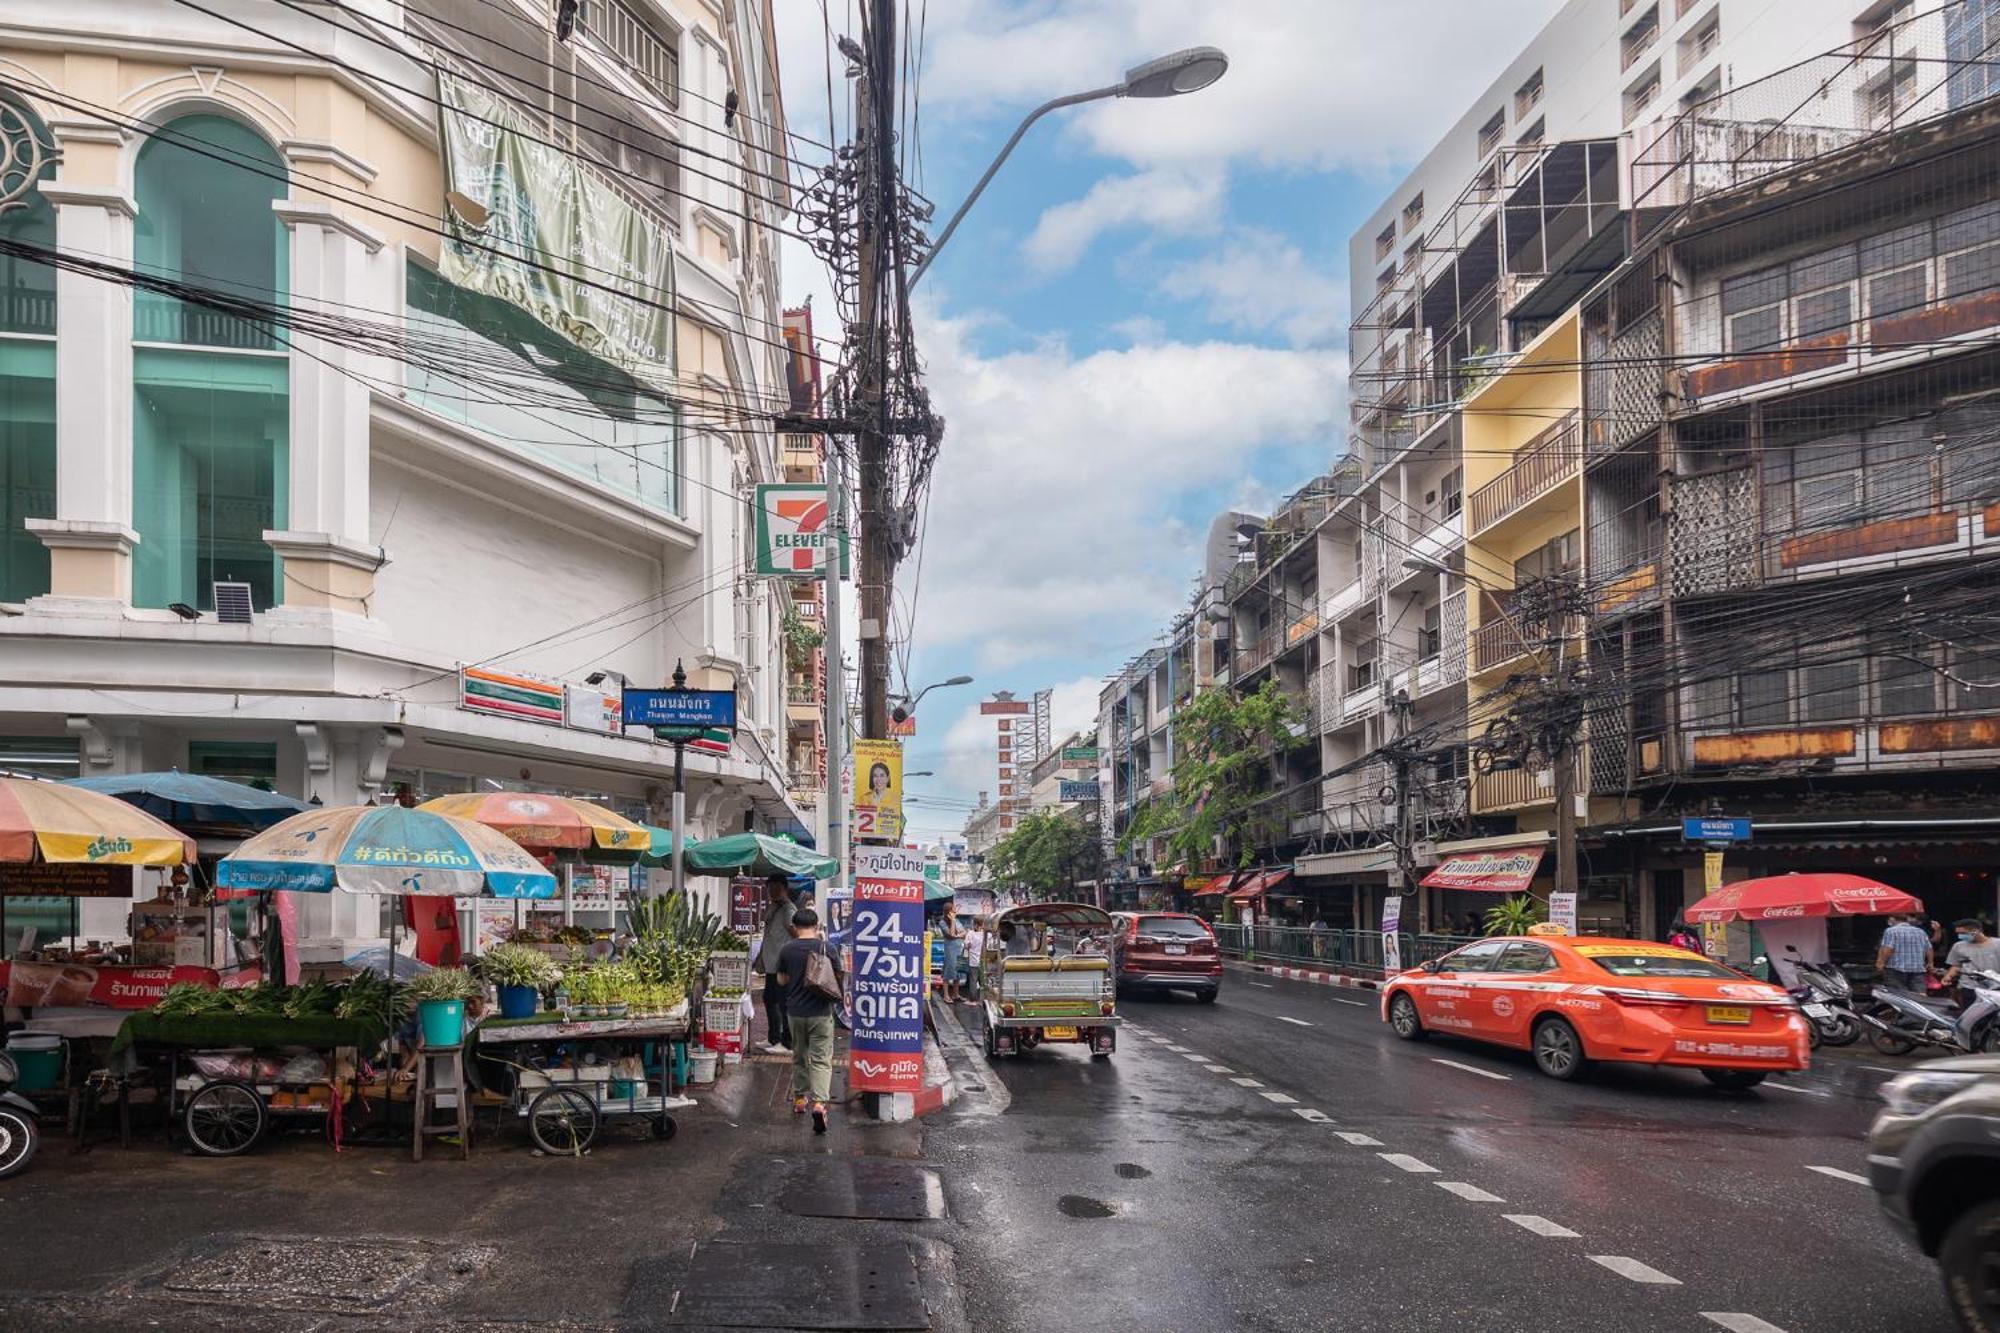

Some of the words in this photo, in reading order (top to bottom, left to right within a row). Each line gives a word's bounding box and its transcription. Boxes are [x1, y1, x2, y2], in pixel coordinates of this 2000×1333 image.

[649, 694, 711, 709] ถนนมังกร
[858, 813, 874, 832] 2
[870, 853, 924, 874] ภูมิใจไทย
[1833, 887, 1888, 897] Coca-Cola
[1763, 906, 1805, 918] Coca-Cola
[856, 911, 903, 943] 24
[855, 978, 919, 994] เราพร้อม
[855, 994, 919, 1028] ดูแล
[854, 1028, 919, 1042] คนกรุงเทพฯ
